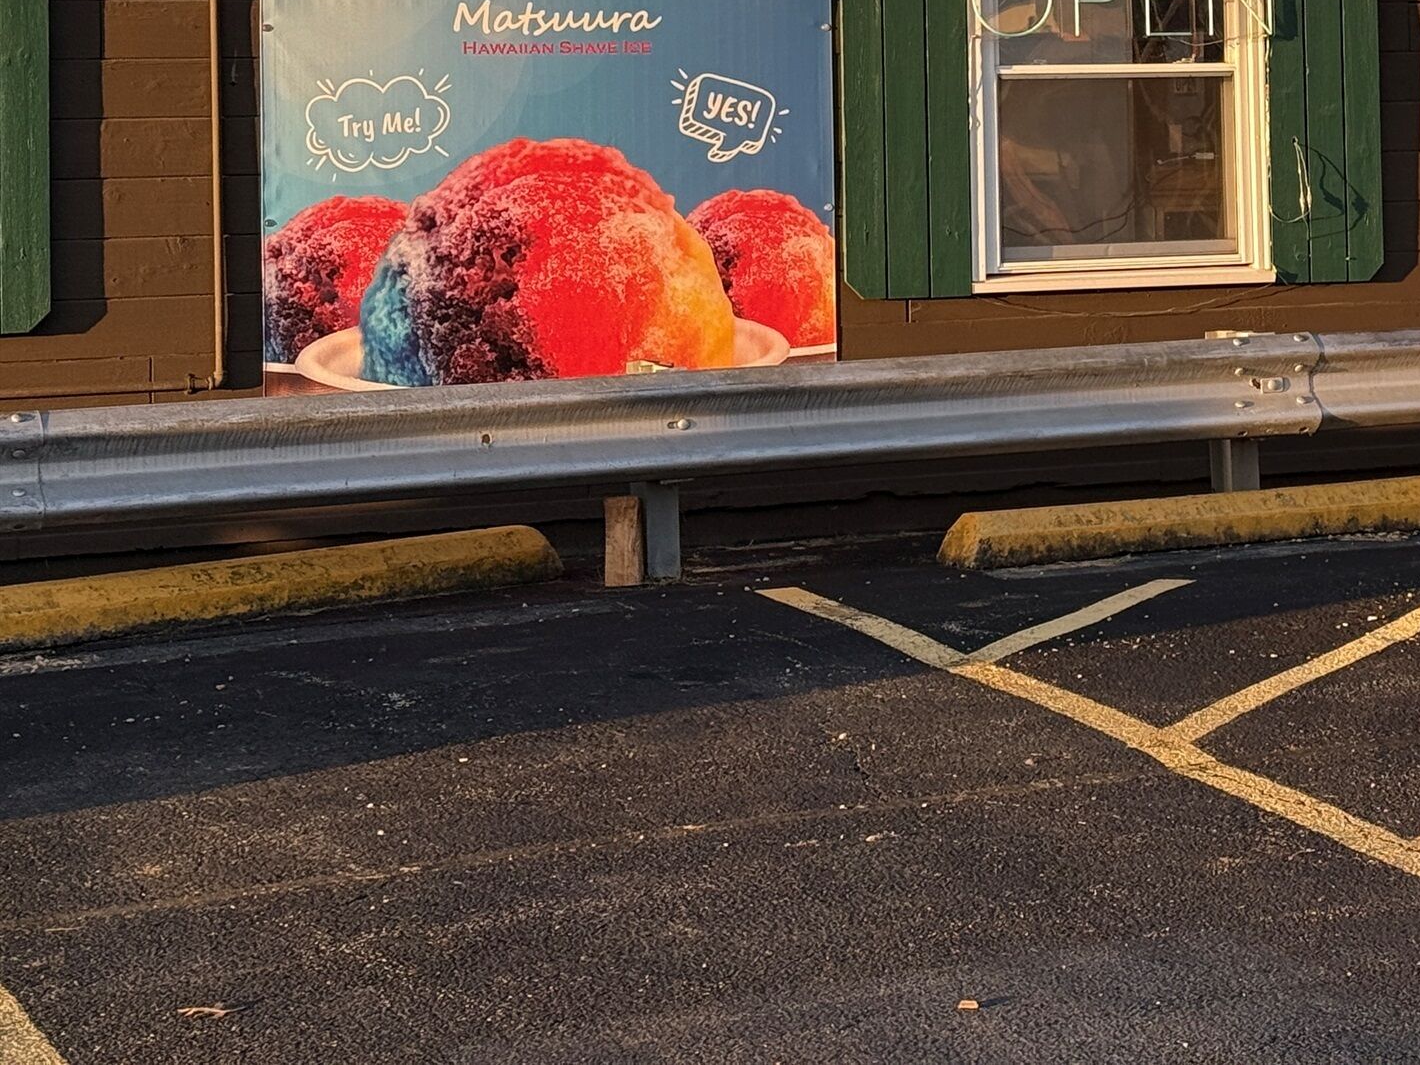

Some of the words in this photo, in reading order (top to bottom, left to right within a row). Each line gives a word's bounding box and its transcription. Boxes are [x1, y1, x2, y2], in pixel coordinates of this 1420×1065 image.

[453, 0, 662, 35] Matsuura
[462, 41, 554, 55] HAWAIIAN
[559, 40, 617, 54] SHAVE
[623, 41, 652, 54] ICE
[337, 114, 375, 143] Try
[382, 107, 421, 135] Me!
[703, 92, 762, 129] YES!
